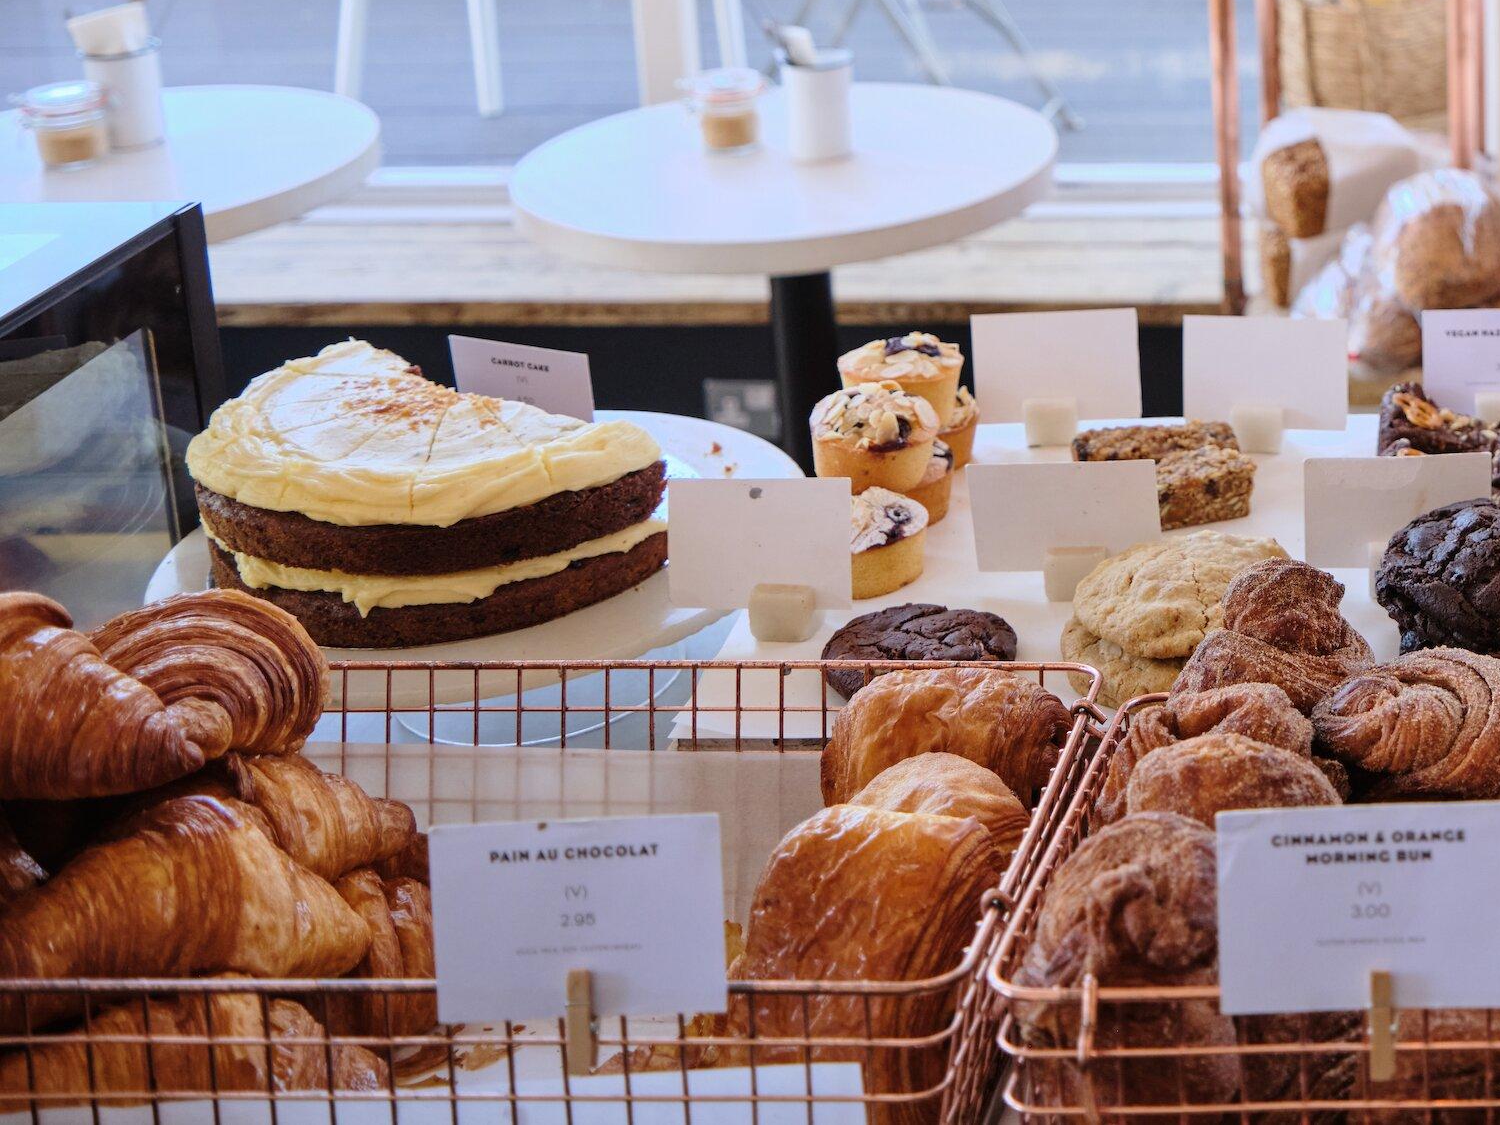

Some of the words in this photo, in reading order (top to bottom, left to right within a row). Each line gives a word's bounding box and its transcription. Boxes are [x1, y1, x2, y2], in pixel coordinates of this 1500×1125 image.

[1445, 330, 1479, 338] VEGAN
[491, 357, 525, 368] CARROT
[527, 362, 550, 372] CAKE
[1271, 832, 1369, 848] CINNAMON
[1374, 831, 1385, 844] &
[1392, 829, 1466, 843] ORANGE
[489, 850, 530, 864] PAIN
[535, 848, 558, 862] AU
[564, 843, 659, 860] CHOCOLAT
[1306, 850, 1391, 865] MORNING
[1396, 849, 1432, 863] BUN
[564, 884, 588, 901] (V)
[1357, 881, 1382, 897] (V)
[1350, 903, 1391, 920] 3.00
[560, 913, 597, 928] 2.95
